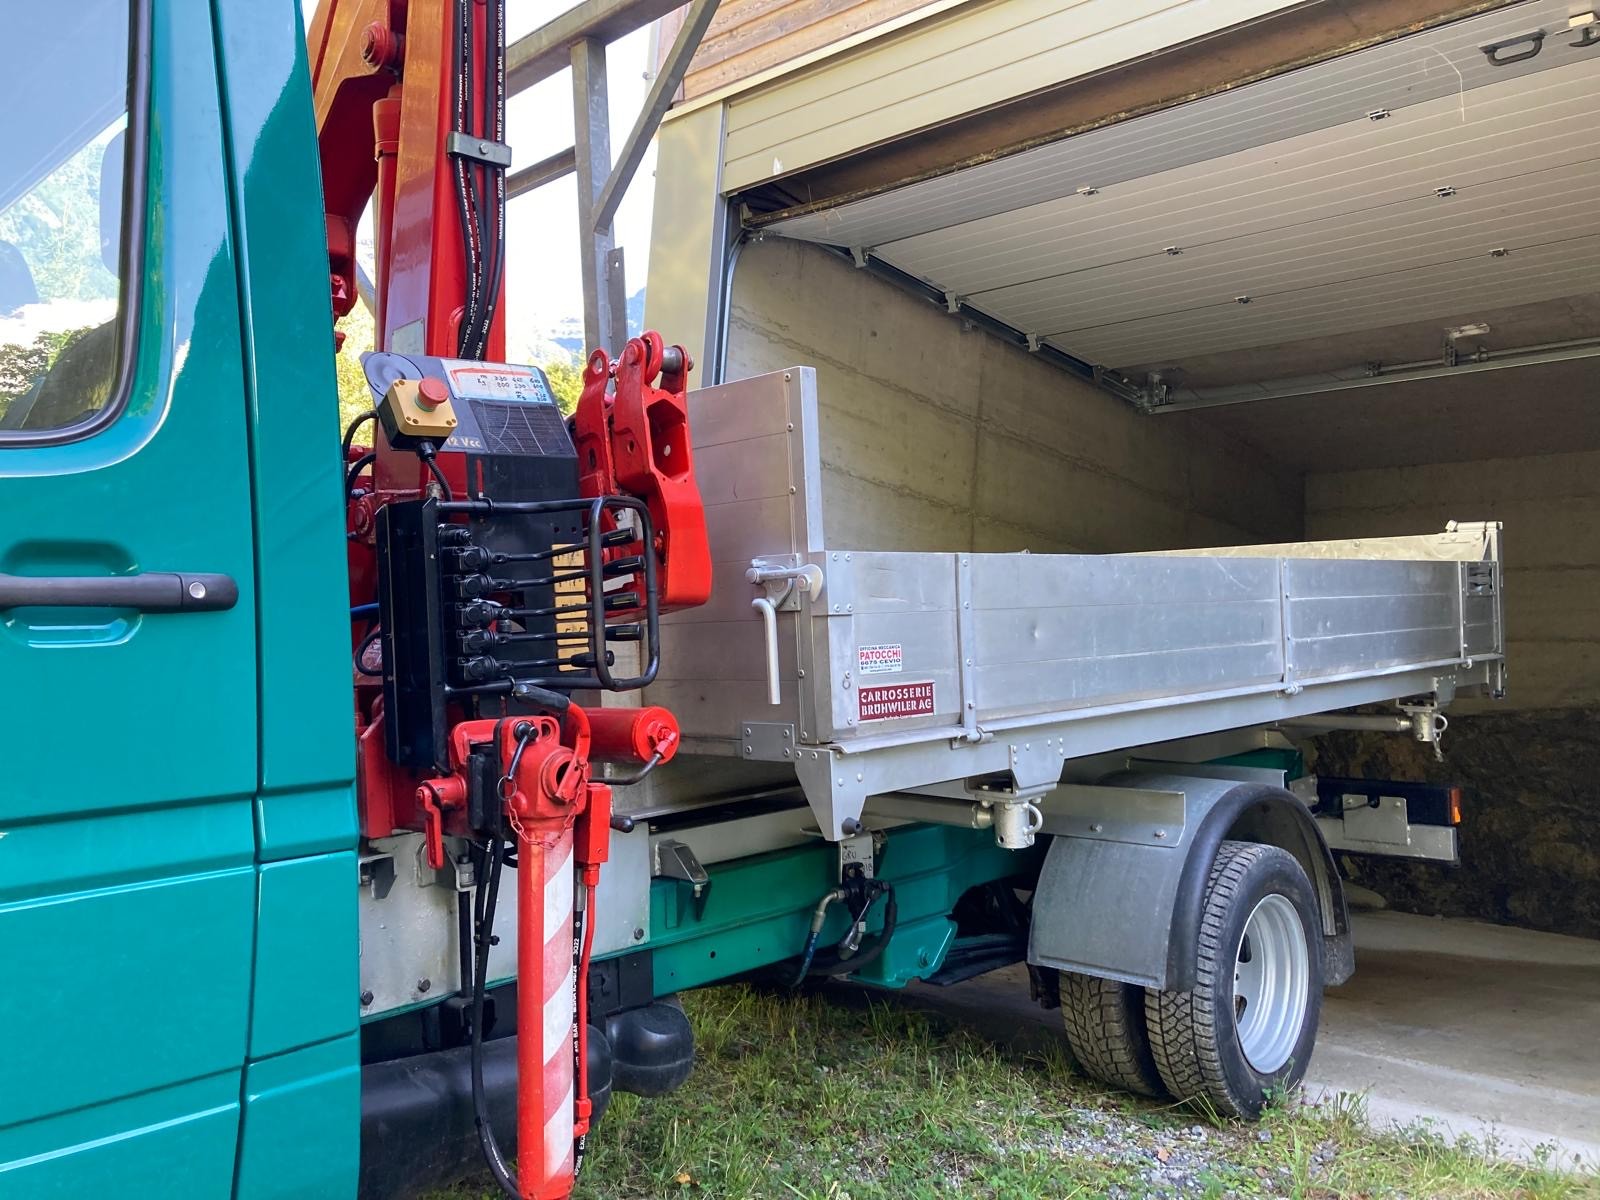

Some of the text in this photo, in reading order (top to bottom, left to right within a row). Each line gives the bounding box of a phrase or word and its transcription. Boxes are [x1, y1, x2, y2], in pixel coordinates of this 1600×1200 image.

[860, 650, 900, 660] PATOCCHI
[861, 686, 931, 702] CARROSSERIE
[918, 699, 932, 709] AG
[843, 851, 856, 860] GRU
